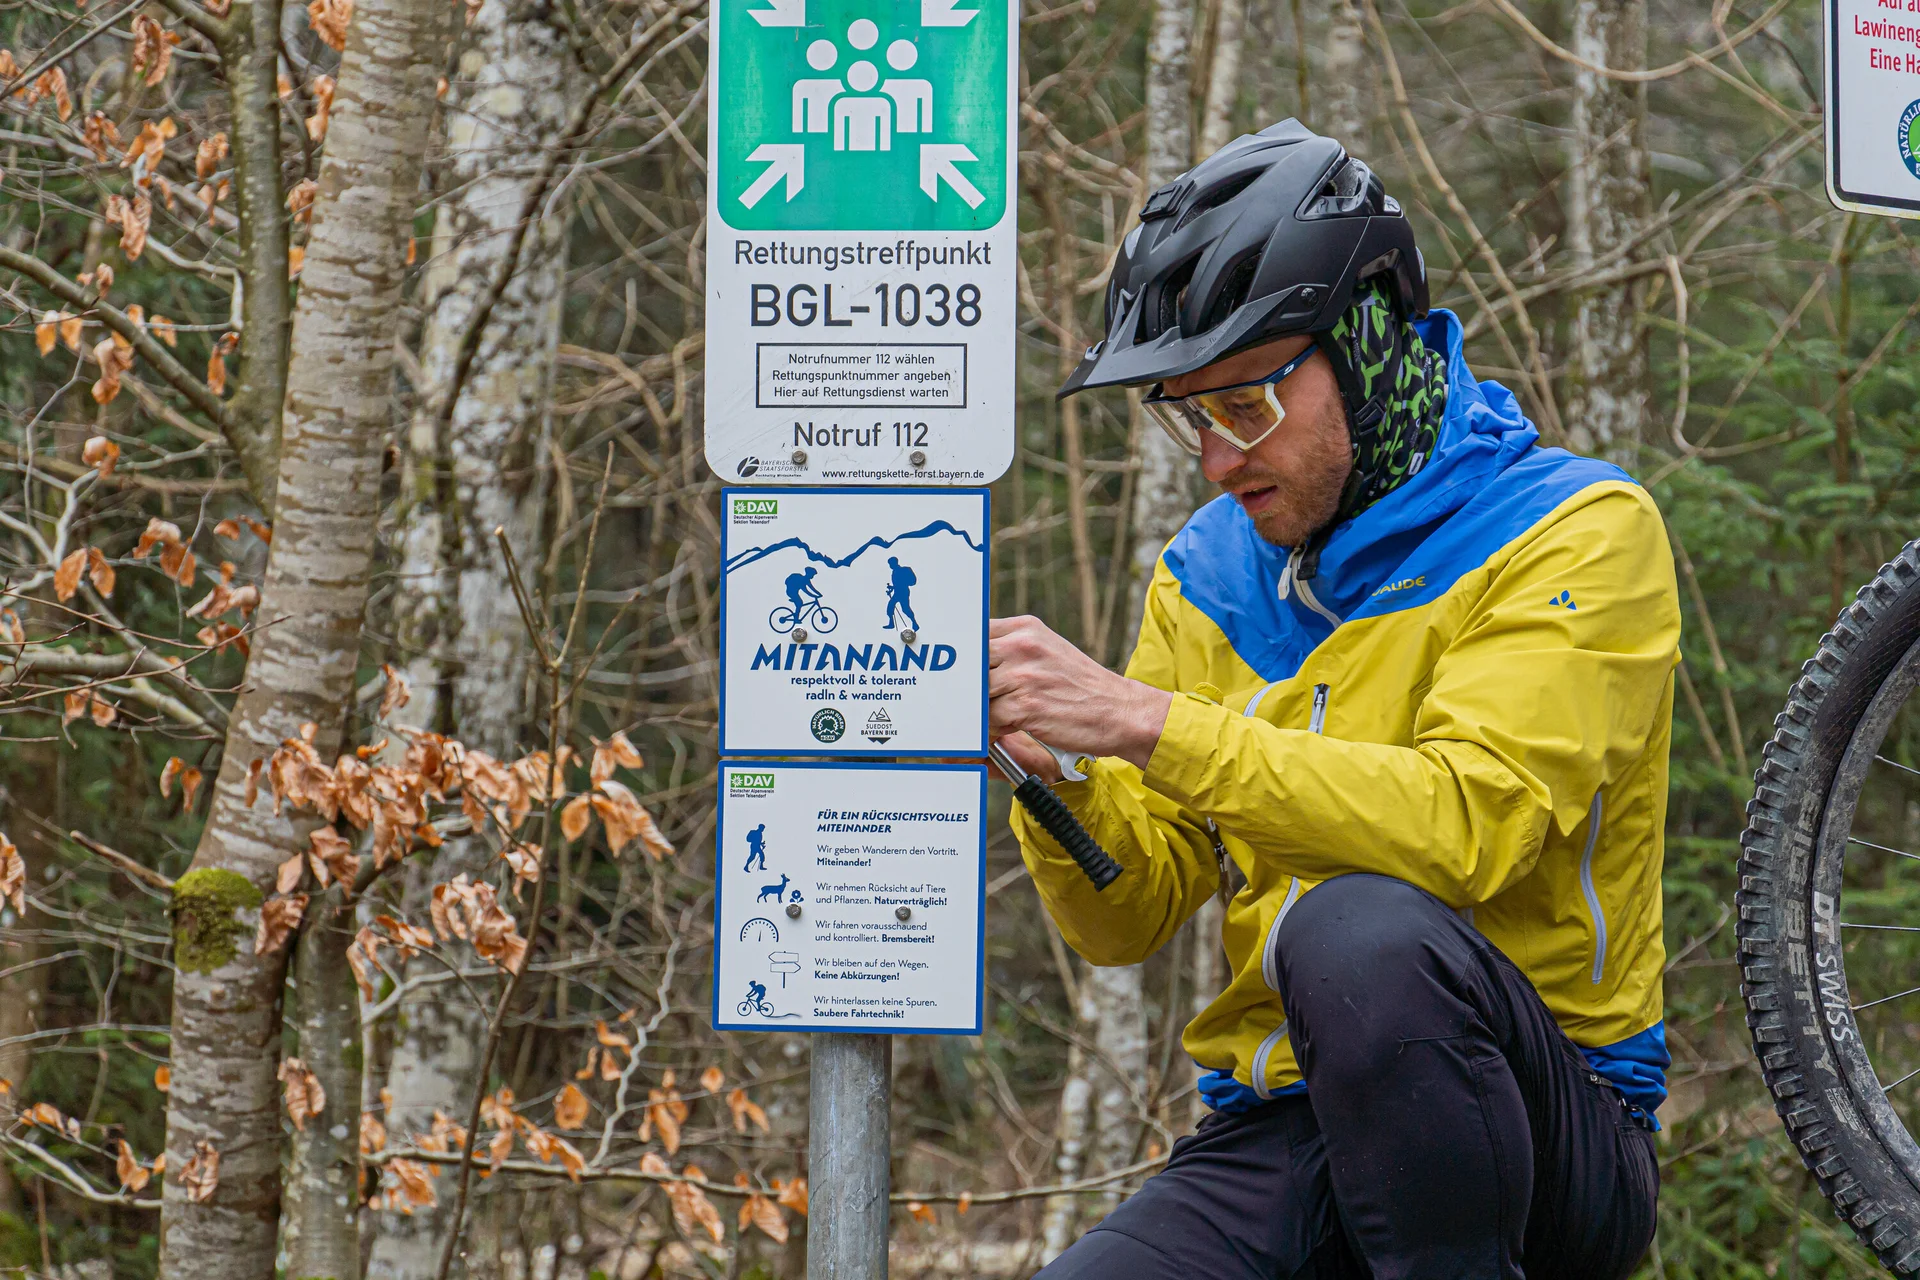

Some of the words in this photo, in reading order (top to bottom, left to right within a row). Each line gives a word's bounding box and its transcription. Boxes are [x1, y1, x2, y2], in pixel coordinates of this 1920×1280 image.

[1870, 48, 1901, 71] Eine
[735, 240, 991, 271] Rettungstreffpunkt
[751, 283, 982, 327] BGL-1038
[788, 354, 872, 364] Notrufnummer
[876, 354, 891, 364] 112
[895, 354, 935, 364] wählen
[772, 370, 900, 382] Rettungspunktnummer
[903, 371, 951, 382] angeben
[774, 387, 798, 398] Hier
[801, 387, 820, 398] auf
[823, 387, 906, 399] Rettungsdienst
[910, 388, 949, 398] warten
[794, 422, 882, 447] Notruf
[892, 422, 929, 447] 112
[822, 469, 985, 480] www.rettungskette-forst.bayern.de
[747, 502, 776, 512] DAV
[750, 642, 957, 671] MITANAND
[791, 674, 855, 687] respektvoll
[858, 675, 867, 685] &
[871, 675, 917, 686] tolerant
[806, 690, 835, 700] radln
[839, 690, 848, 700] &
[851, 690, 902, 700] wandern
[744, 775, 773, 786] DAV
[817, 809, 838, 820] FÜR
[841, 811, 859, 820] EIN
[862, 810, 969, 822] RÜCKSICHTSVOLLES
[817, 824, 892, 833] MITEINANDER
[817, 845, 833, 855] Wir
[834, 846, 860, 857] geben
[862, 846, 907, 855] Wanderern
[909, 847, 926, 855] den
[927, 847, 958, 856] Vortritt.
[817, 858, 871, 867] Miteinander!
[816, 882, 832, 892] Wir
[833, 883, 866, 893] nehmen
[868, 883, 908, 893] Rücksicht
[910, 884, 924, 893] auf
[925, 884, 946, 894] Tiere
[816, 895, 832, 905] und
[834, 895, 872, 905] Pflanzen.
[874, 896, 947, 908] Naturverträglich!
[1812, 890, 1836, 946] DT
[815, 920, 831, 930] Wir
[833, 920, 859, 930] fahren
[861, 922, 927, 932] vorausschauend
[815, 933, 831, 942] und
[833, 933, 880, 943] kontrolliert.
[881, 934, 935, 944] Bremsbereit!
[815, 958, 830, 968] Wir
[832, 959, 863, 968] bleiben
[864, 959, 878, 969] auf
[880, 959, 896, 969] den
[897, 959, 929, 970] Wegen.
[814, 971, 838, 981] Keine
[840, 971, 900, 983] Abkürzungen!
[814, 996, 830, 1005] Wir
[831, 996, 880, 1006] hinterlassen
[881, 997, 904, 1006] keine
[905, 997, 937, 1009] Spuren.
[1816, 952, 1853, 1042] SWISS
[813, 1009, 849, 1018] Saubere
[851, 1009, 904, 1019] Fahrtechnik!
